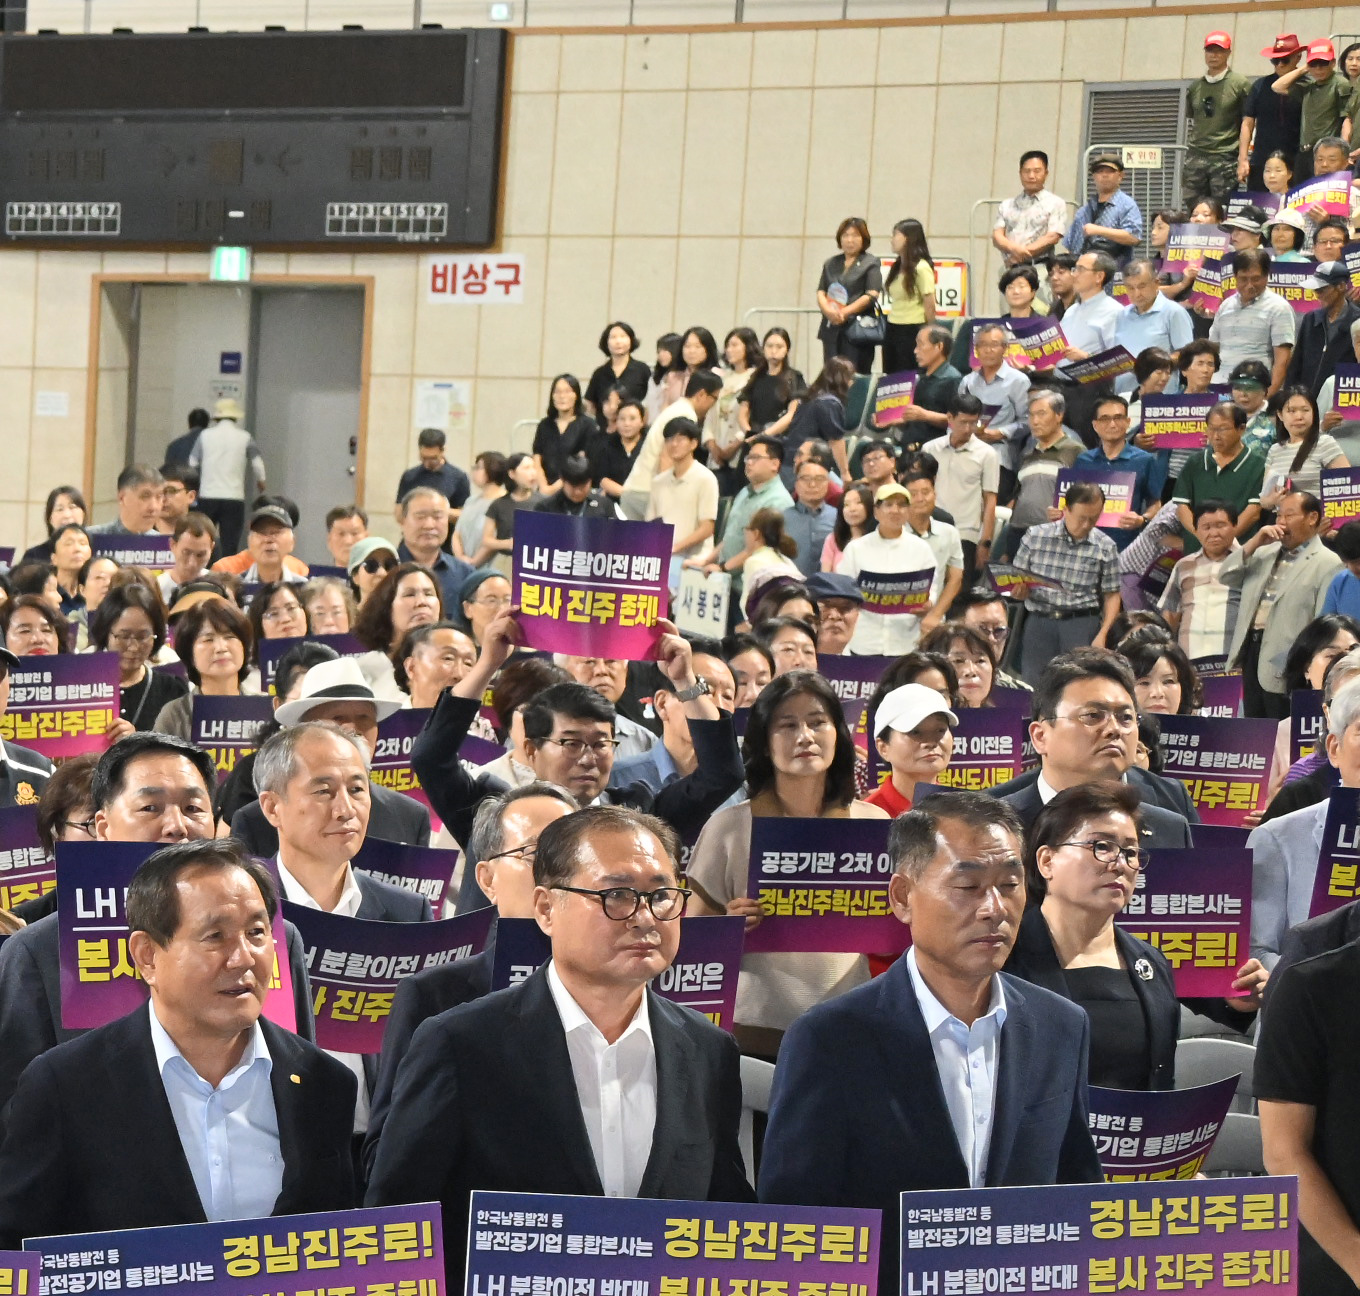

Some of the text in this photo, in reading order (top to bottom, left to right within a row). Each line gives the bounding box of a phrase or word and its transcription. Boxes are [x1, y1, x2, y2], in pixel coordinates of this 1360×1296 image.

[431, 262, 522, 296] 비상구
[522, 545, 661, 581] LH 분할이전 반대!
[521, 582, 658, 627] 본사 진주 존치!
[55, 683, 113, 700] 통합본사는
[971, 736, 1013, 755] 이전은
[1199, 752, 1266, 770] 통합본사는
[762, 852, 873, 875] 공공기관 2차
[75, 888, 117, 918] LH
[1151, 893, 1242, 916] 통합본사는
[320, 949, 419, 979] 분할이전
[660, 963, 724, 993] 이전은
[1144, 1120, 1219, 1157] 통합본사는
[477, 1210, 563, 1229] 한국남동발전 등
[908, 1206, 992, 1223] 한국남동발전 등
[908, 1193, 1288, 1249] 발전공기업 통합본사는 경남진주로!
[476, 1218, 869, 1263] 발전공기업 통합본사는 경남진주로!
[39, 1221, 433, 1296] 발전공기업 통합본사는 경남진주로!
[107, 1249, 120, 1265] 등
[908, 1249, 1289, 1296] LH 분할이전 반대! 본사 진주 존치!
